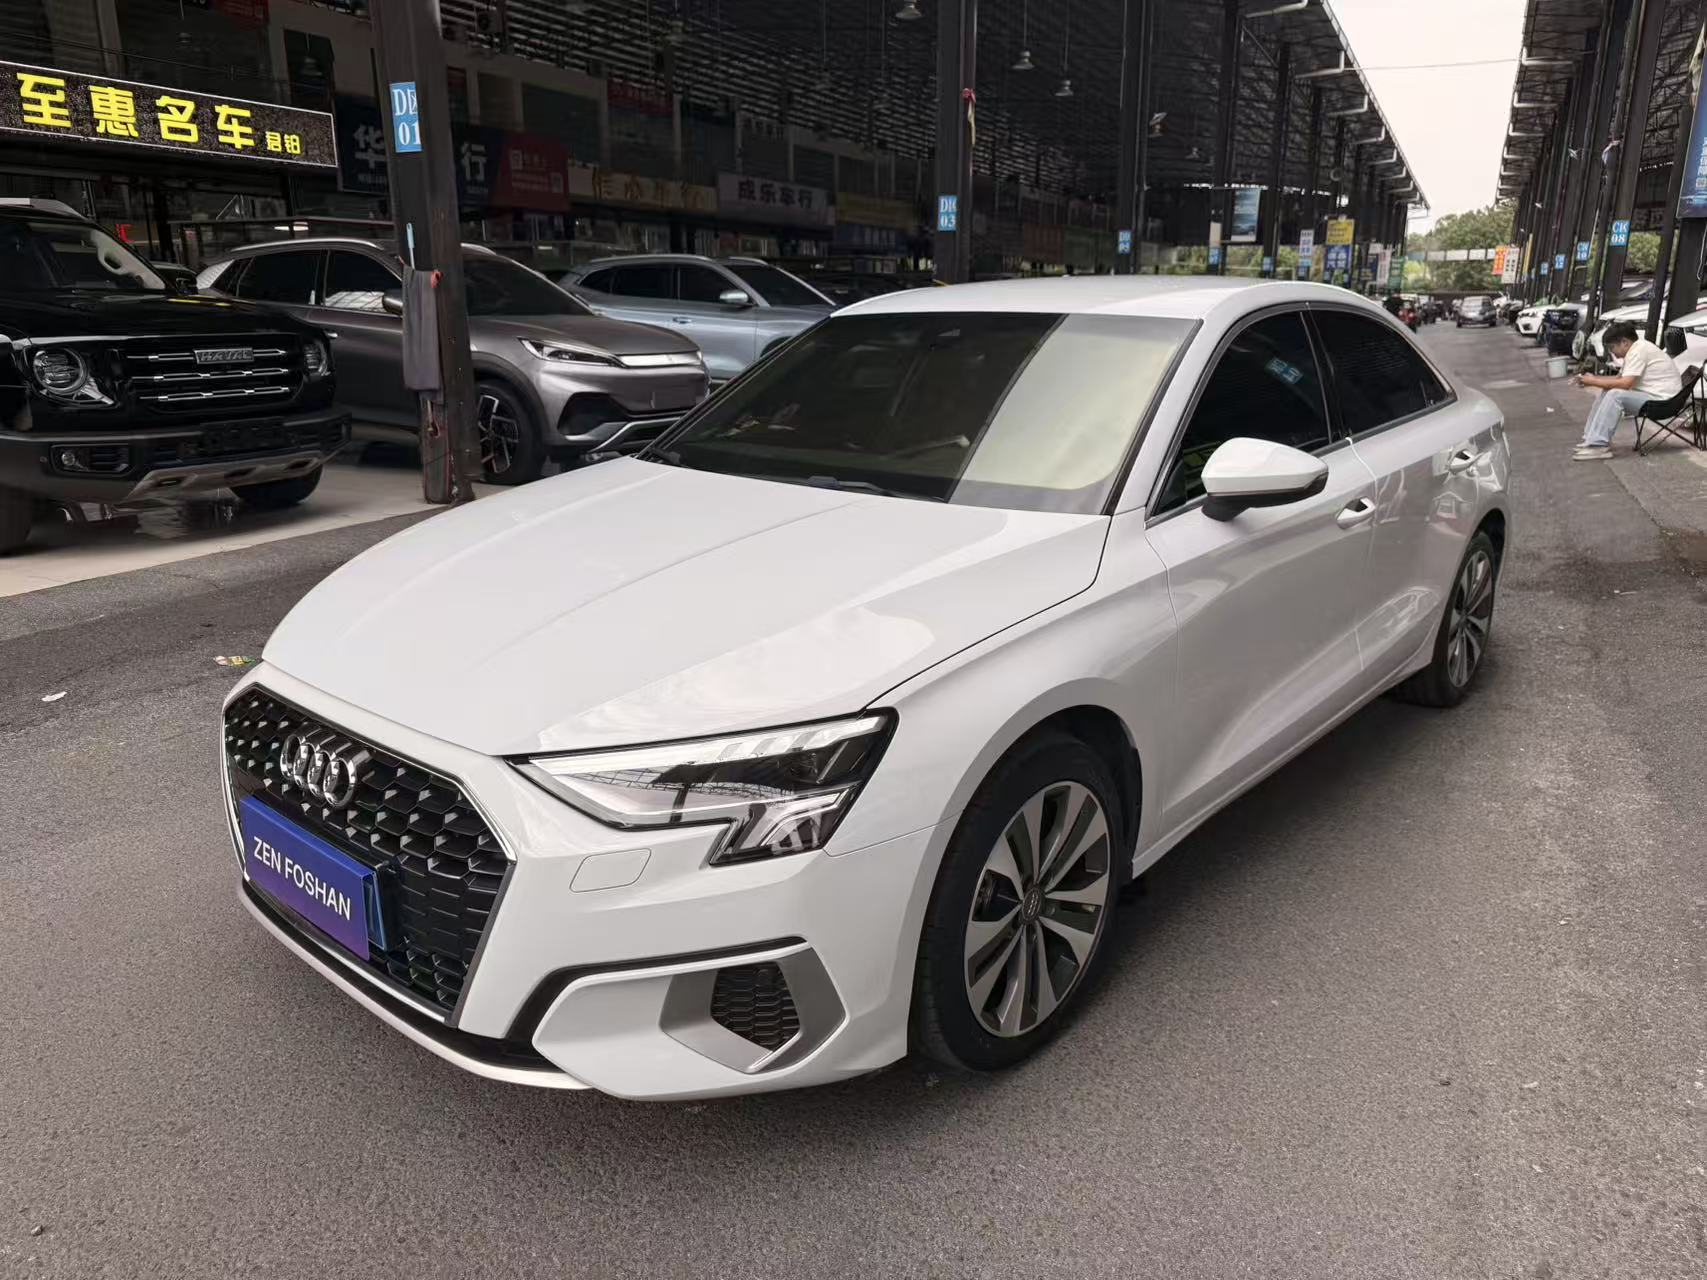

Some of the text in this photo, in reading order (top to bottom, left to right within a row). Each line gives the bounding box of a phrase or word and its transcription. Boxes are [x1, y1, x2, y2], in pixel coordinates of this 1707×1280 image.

[16, 72, 255, 149] 至惠名车
[1611, 233, 1625, 243] 08
[253, 836, 351, 921] ZEN FOSHAN
